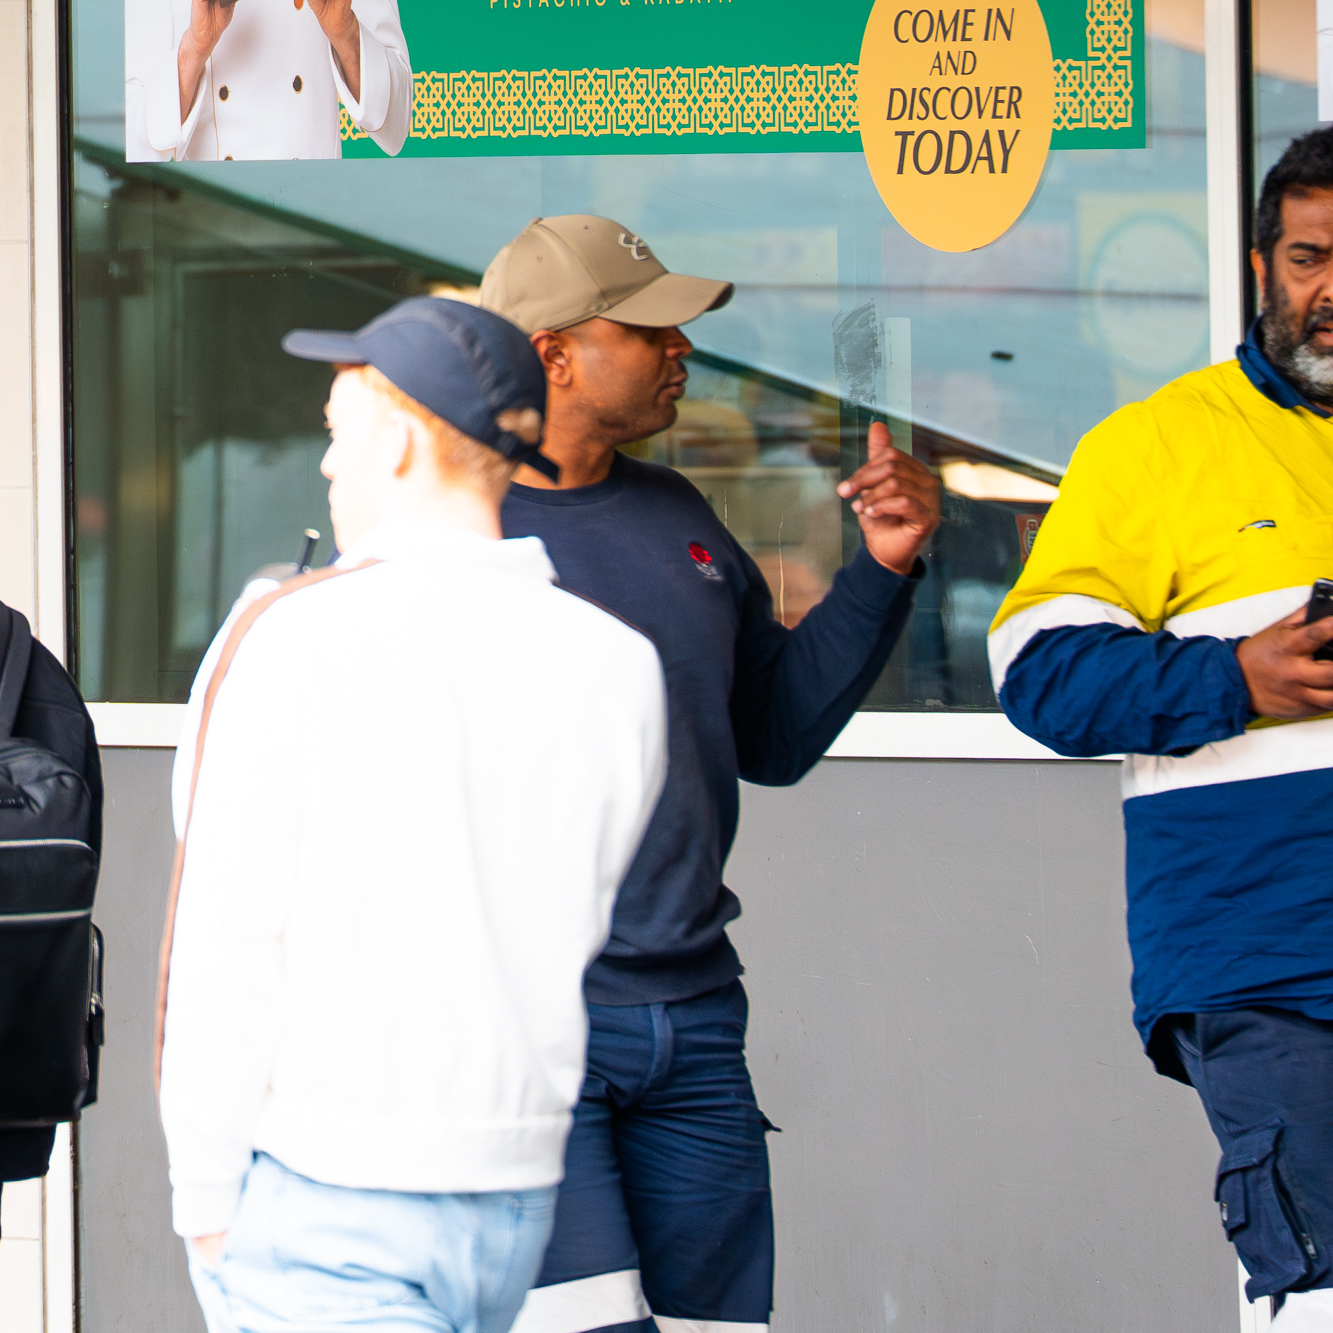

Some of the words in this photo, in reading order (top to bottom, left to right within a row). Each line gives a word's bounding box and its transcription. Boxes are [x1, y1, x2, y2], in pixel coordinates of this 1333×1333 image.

[893, 8, 975, 44] COME
[983, 7, 1015, 42] IN
[929, 50, 977, 76] AND
[886, 85, 1023, 121] DISCOVER
[893, 129, 1021, 175] TODAY
